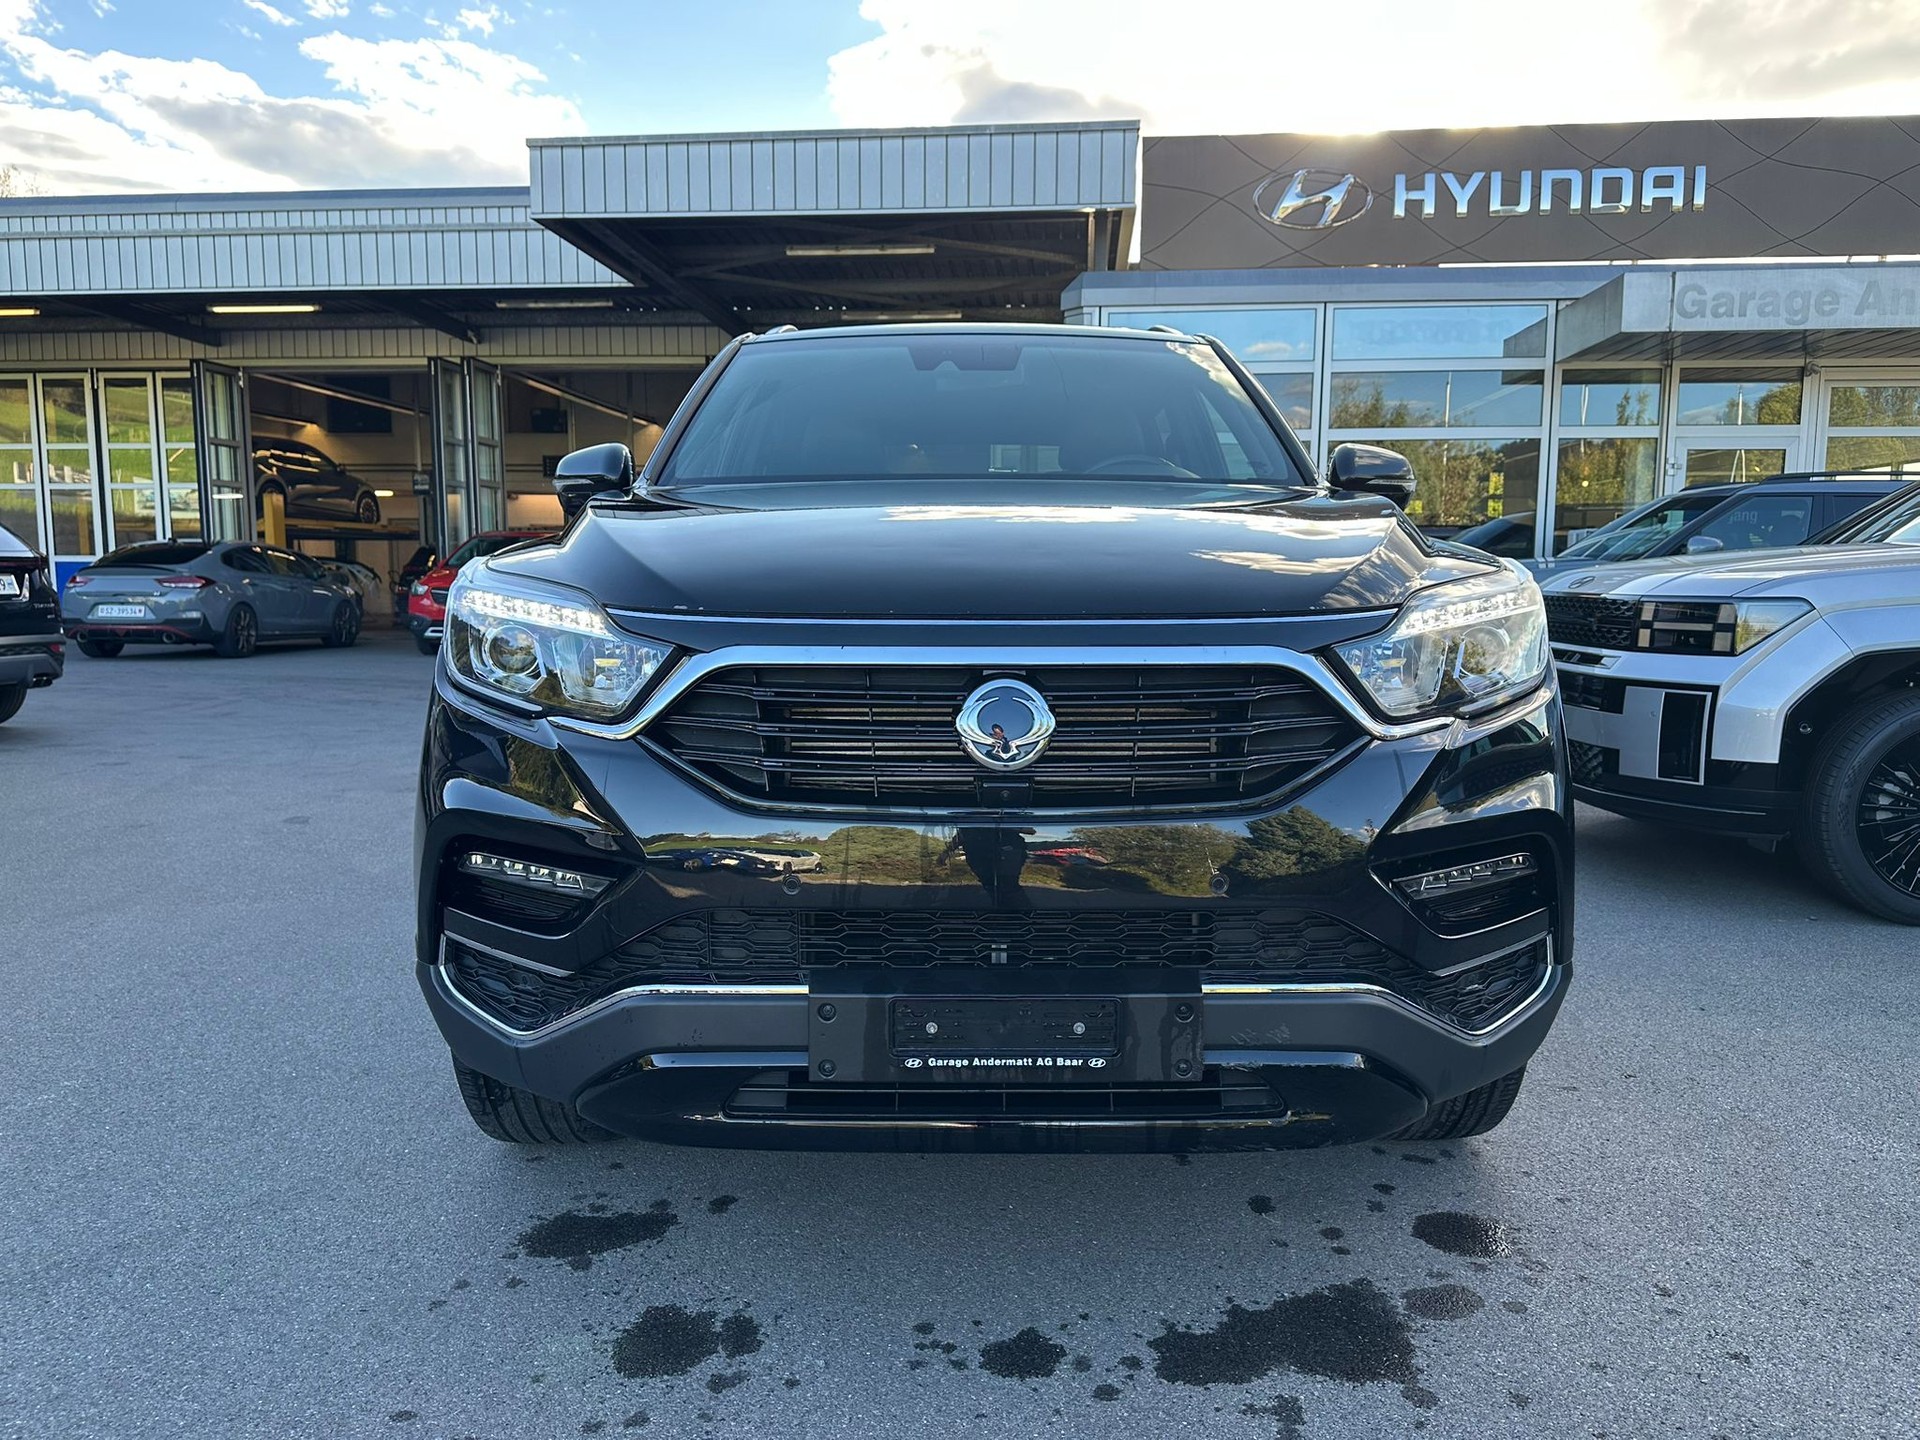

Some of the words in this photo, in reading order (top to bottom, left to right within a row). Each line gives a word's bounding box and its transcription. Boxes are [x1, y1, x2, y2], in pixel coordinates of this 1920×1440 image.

[1393, 165, 1707, 219] HYUNDAI
[1675, 282, 1840, 326] Garage
[928, 1057, 969, 1068] Garage
[972, 1057, 1033, 1066] Andermatt
[1036, 1057, 1053, 1066] AG
[1056, 1057, 1084, 1066] Baar
